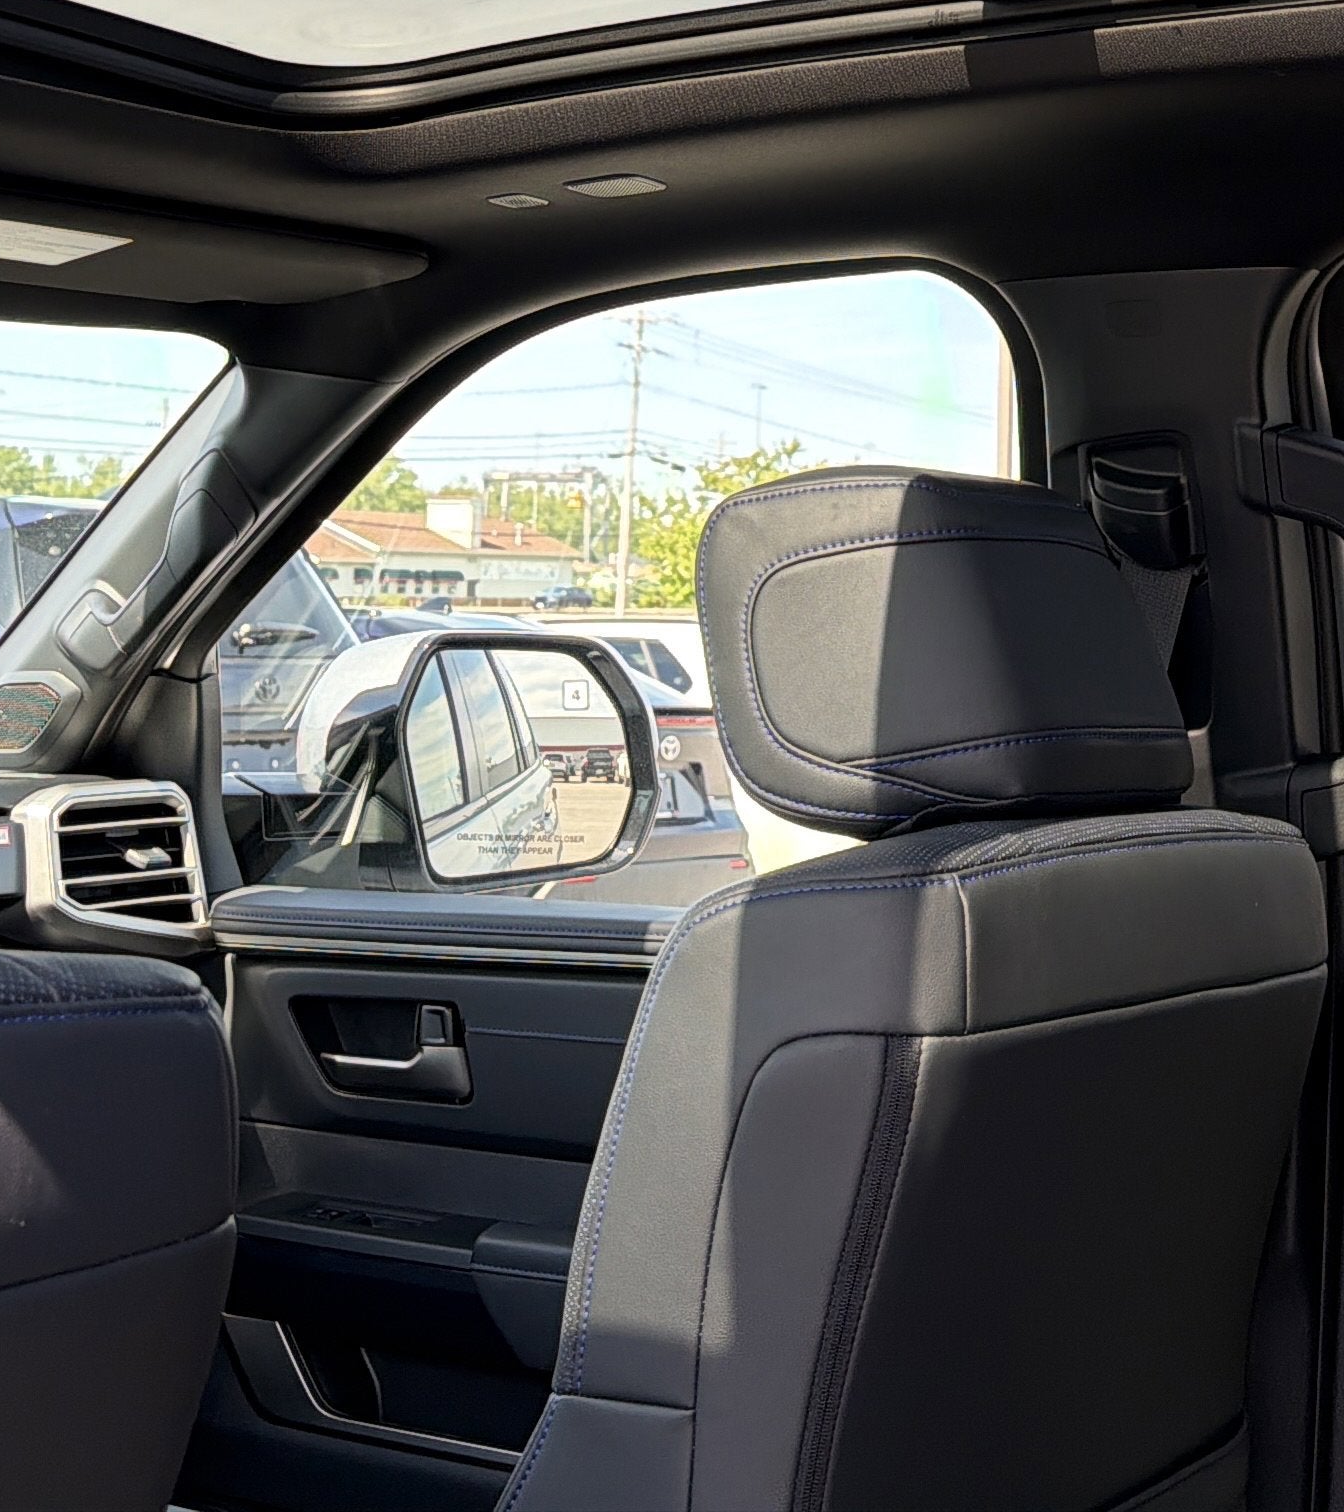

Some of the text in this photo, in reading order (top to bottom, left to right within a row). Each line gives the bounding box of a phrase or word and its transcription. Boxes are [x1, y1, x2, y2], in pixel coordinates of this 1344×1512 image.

[456, 832, 585, 843] OBJECTS IN MIRROR ARE CLOSER
[478, 846, 553, 855] THAN THEY APPEAR
